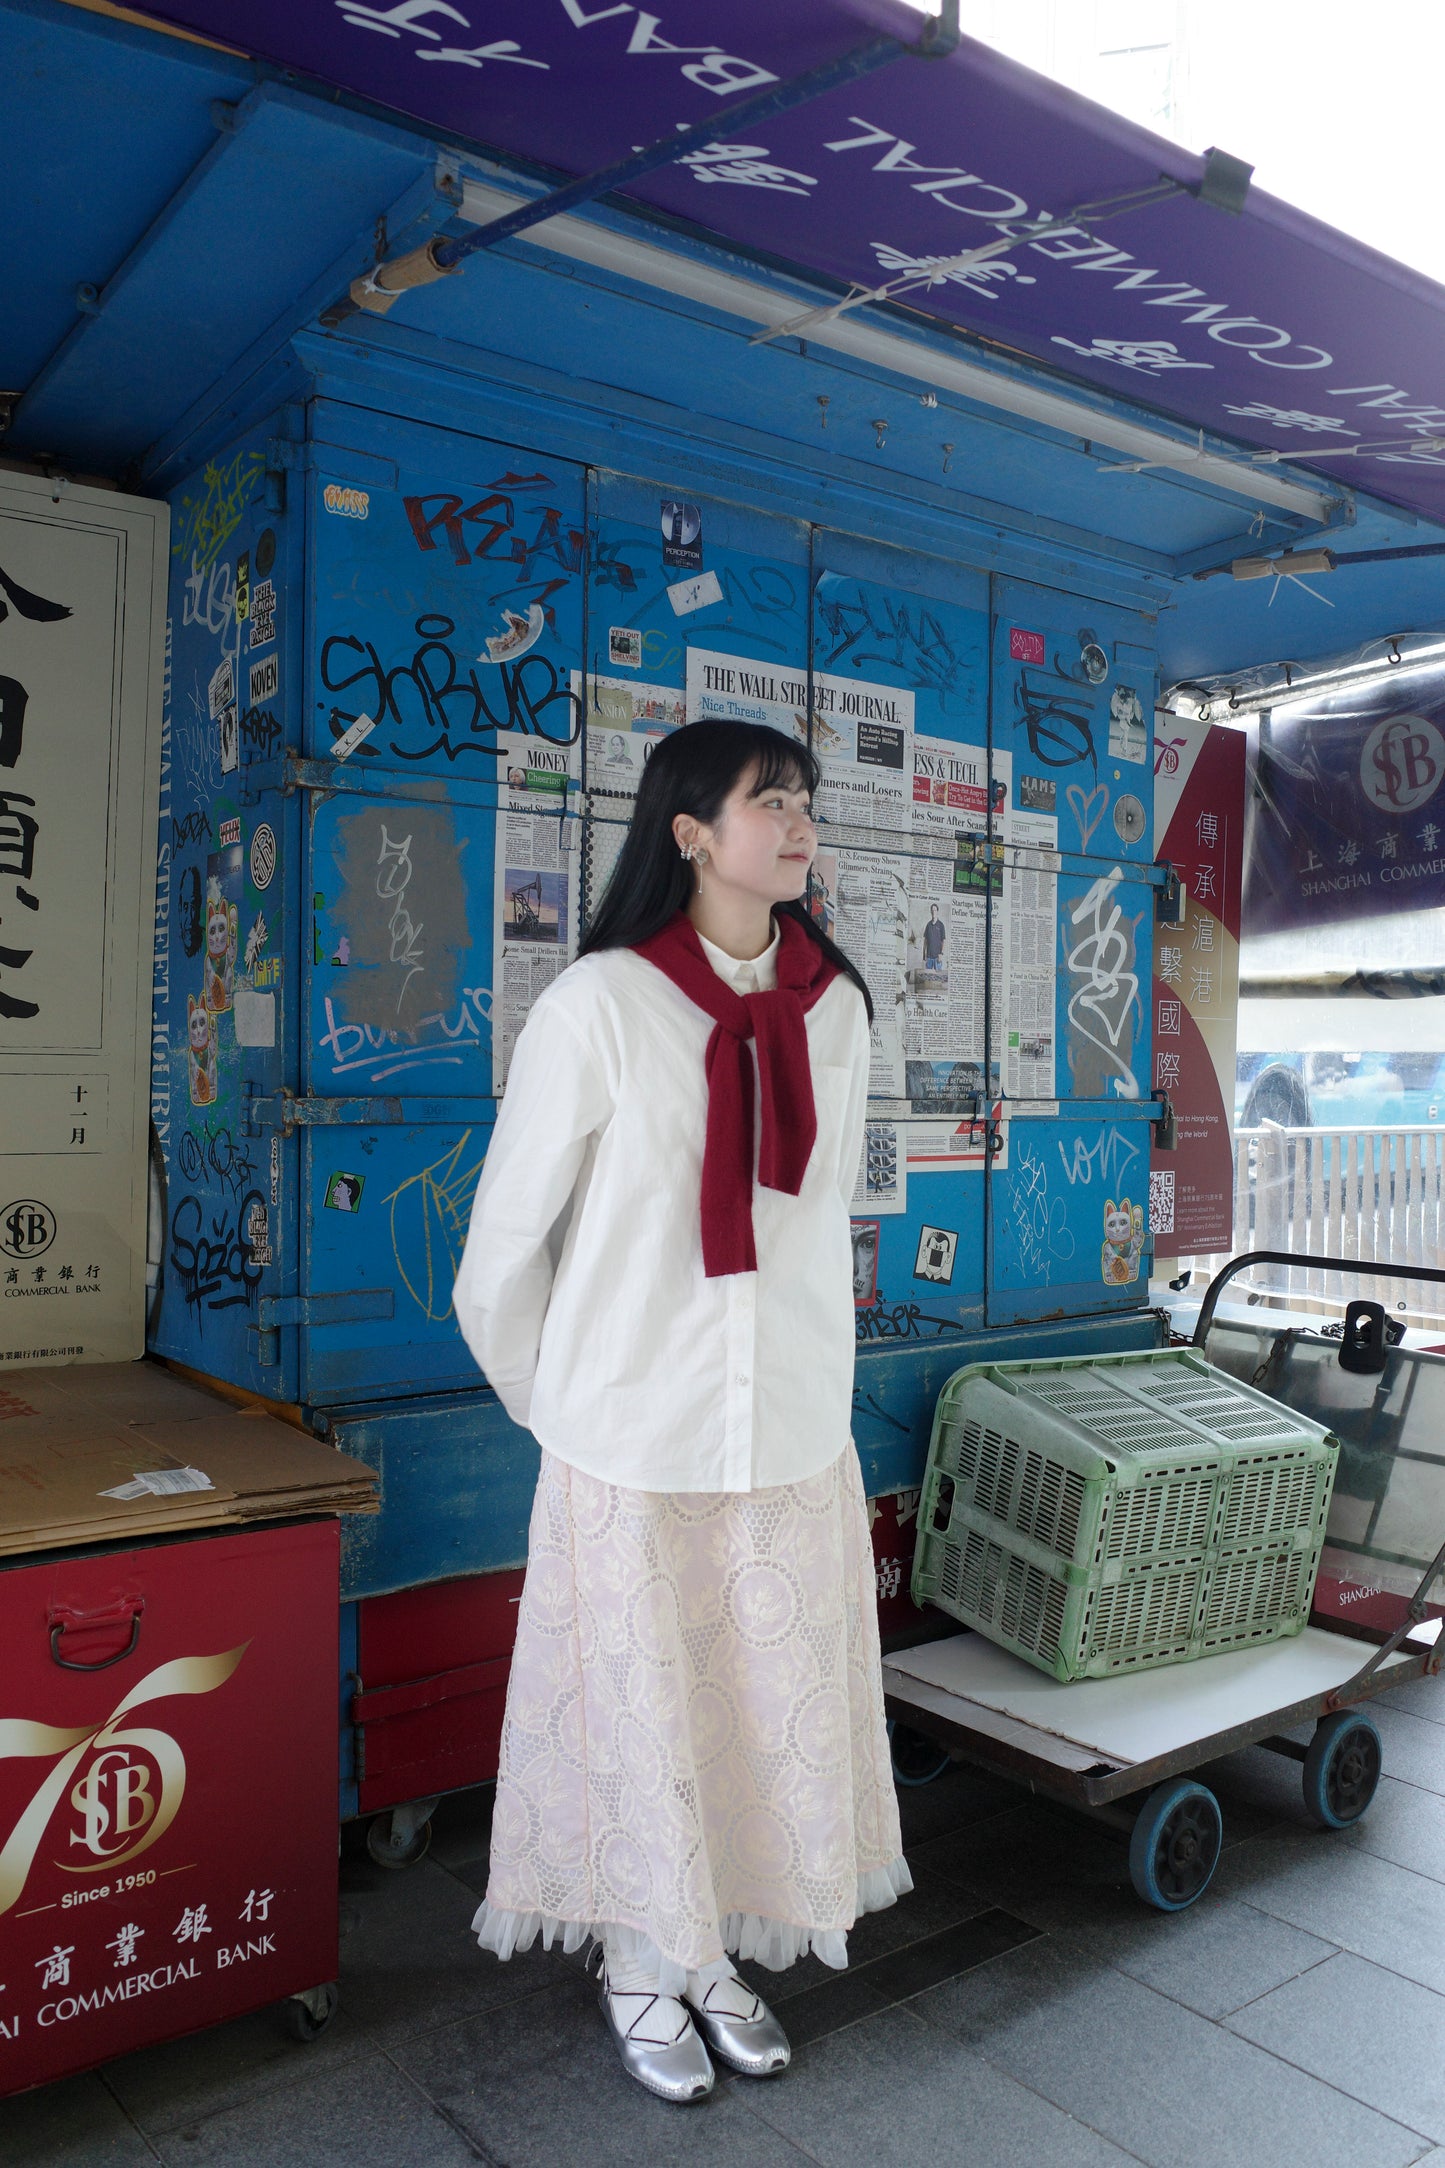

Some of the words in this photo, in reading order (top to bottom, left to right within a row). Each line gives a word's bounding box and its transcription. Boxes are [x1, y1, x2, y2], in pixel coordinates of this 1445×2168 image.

[822, 116, 1334, 370] COMMERCIAL
[665, 547, 700, 559] PERCEPTION
[256, 582, 271, 599] THE
[250, 594, 276, 619] BLACK
[250, 624, 275, 647] PATCH
[611, 629, 624, 638] YETI
[626, 631, 640, 640] OUT
[611, 652, 640, 662] SHELVING
[251, 661, 277, 699] KOVEN
[703, 664, 736, 694] THE
[738, 672, 778, 702] WALL
[780, 680, 838, 713] STREET
[701, 696, 725, 713] Nice
[726, 701, 767, 721] Threads
[527, 749, 569, 773] MONEY
[914, 753, 935, 777] ESS
[936, 758, 946, 779] &
[947, 759, 979, 785] TECH.
[526, 771, 562, 786] Cheering
[819, 778, 850, 791] inners
[851, 780, 869, 794] and
[871, 781, 903, 798] Losers
[1021, 775, 1057, 794] JAMS
[911, 810, 925, 821] les
[926, 811, 945, 824] Sour
[946, 813, 966, 828] After
[838, 849, 852, 860] U.S.
[852, 851, 881, 865] Economy
[881, 855, 901, 865] Shows
[1300, 822, 1441, 874] 上海商業
[838, 860, 870, 874] Glimmers,
[1301, 872, 1371, 897] SHANGHAI
[951, 899, 974, 910] Startups
[951, 908, 969, 916] Define
[1190, 810, 1219, 1004] 傳承滬港
[153, 842, 171, 1004] STREET
[519, 945, 537, 955] Small
[537, 947, 558, 956] Drillers
[516, 1003, 530, 1014] Soap
[913, 1008, 934, 1018] Health
[934, 1009, 948, 1018] Care
[950, 1077, 971, 1085] BETWEEN
[69, 1085, 89, 1146] 十一月
[1190, 1114, 1205, 1124] Hong
[1193, 1129, 1208, 1138] World
[3, 1263, 102, 1285] 商業銀行
[4, 1285, 70, 1298] COMMERCIAL
[75, 1282, 102, 1294] BANK
[61, 1884, 111, 1909] Since
[115, 1869, 157, 1894] 1950
[35, 1888, 276, 1991] 商業銀行
[37, 1956, 202, 2027] COMMERCIAL
[217, 1932, 277, 1969] BANK
